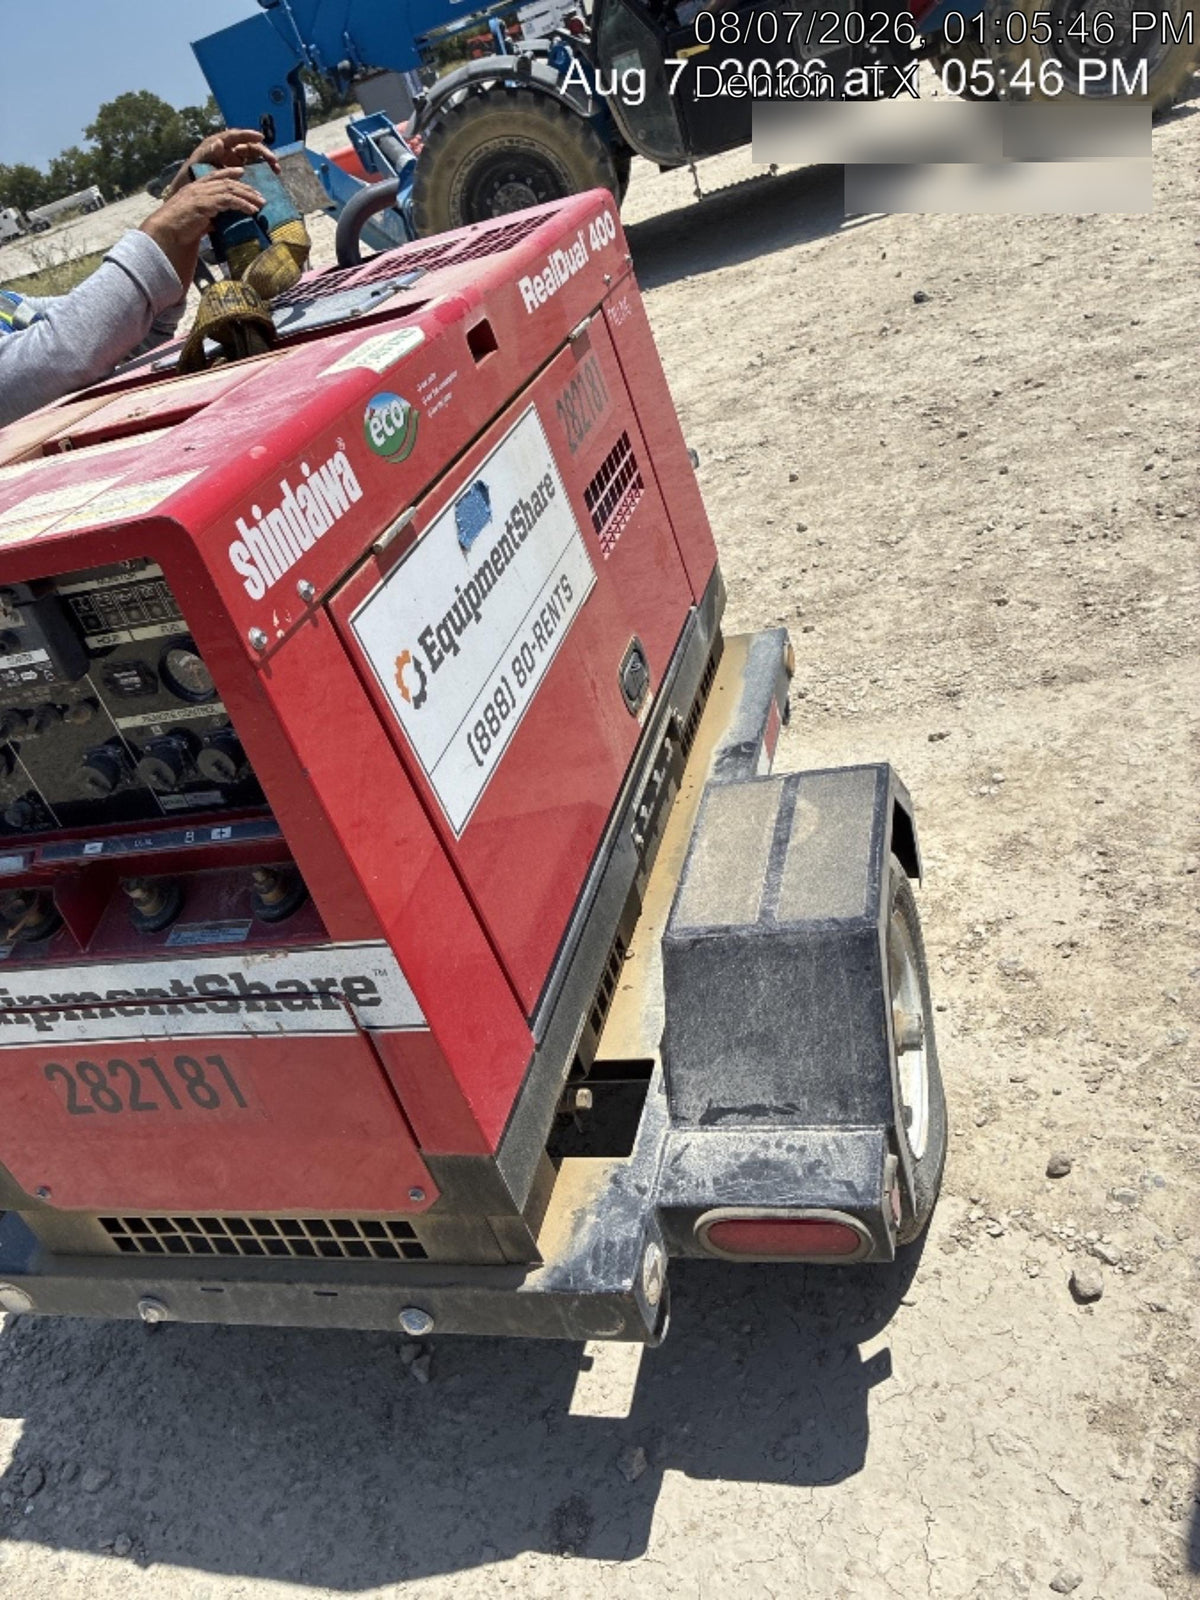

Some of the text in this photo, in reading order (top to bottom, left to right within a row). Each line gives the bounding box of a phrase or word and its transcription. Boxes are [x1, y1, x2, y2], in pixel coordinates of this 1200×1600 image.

[516, 231, 590, 315] RealDual
[588, 209, 617, 252] 400
[227, 450, 364, 602] shindaiwa
[416, 472, 556, 675] EquipmentShare
[466, 573, 575, 768] (888) 80-RENTS
[43, 1053, 249, 1117] 282181
